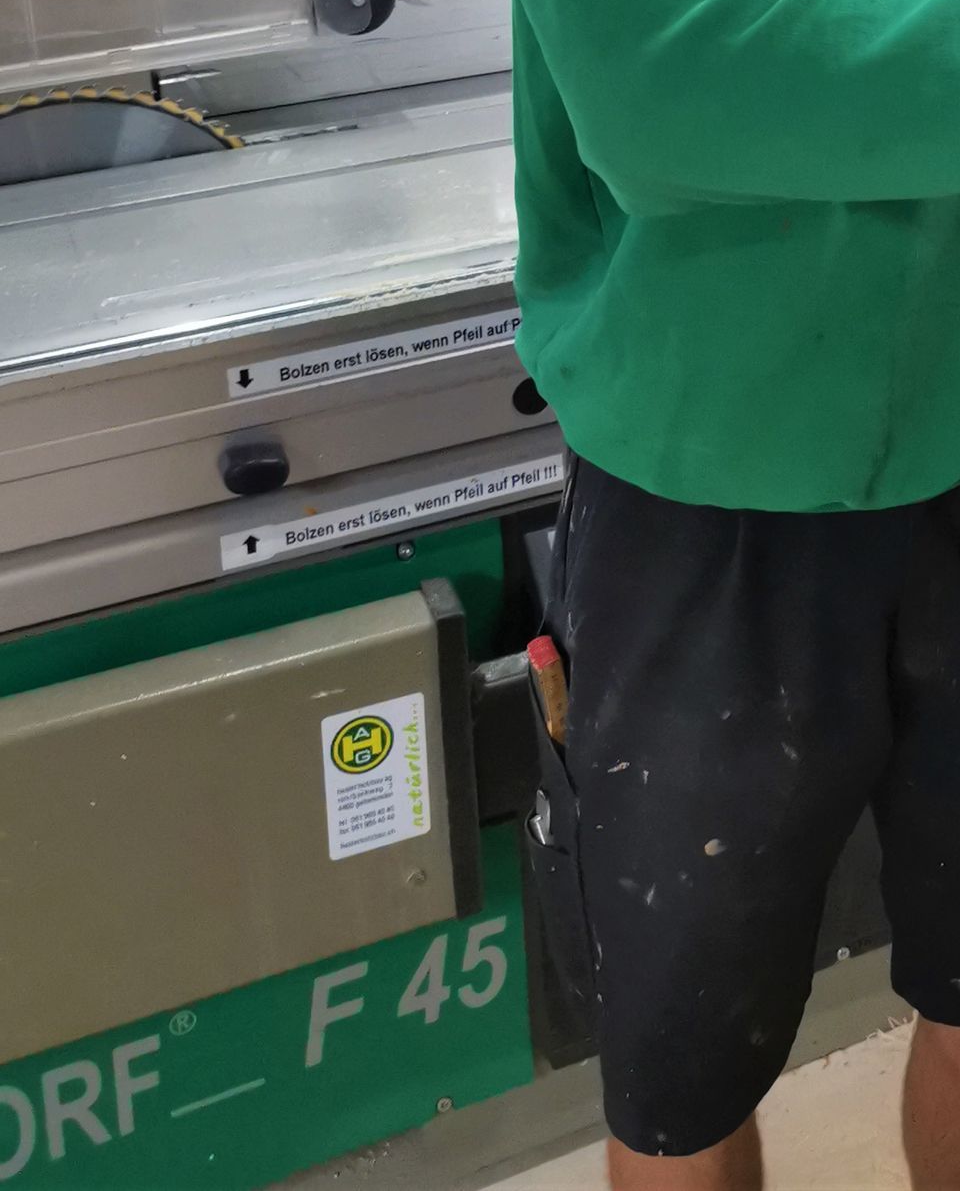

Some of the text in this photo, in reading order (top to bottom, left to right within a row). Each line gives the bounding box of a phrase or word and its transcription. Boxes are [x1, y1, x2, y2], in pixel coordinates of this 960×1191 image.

[279, 362, 330, 382] Bolzen
[334, 353, 362, 370] erst
[365, 344, 409, 364] lösen,
[412, 335, 450, 352] wenn
[453, 325, 484, 344] Pfeil
[487, 319, 509, 337] auf
[285, 464, 558, 545] Bolzen erst lösen, wenn Pfeil auf Pfeil !!!
[304, 960, 369, 1068] F
[396, 915, 508, 1025] 45
